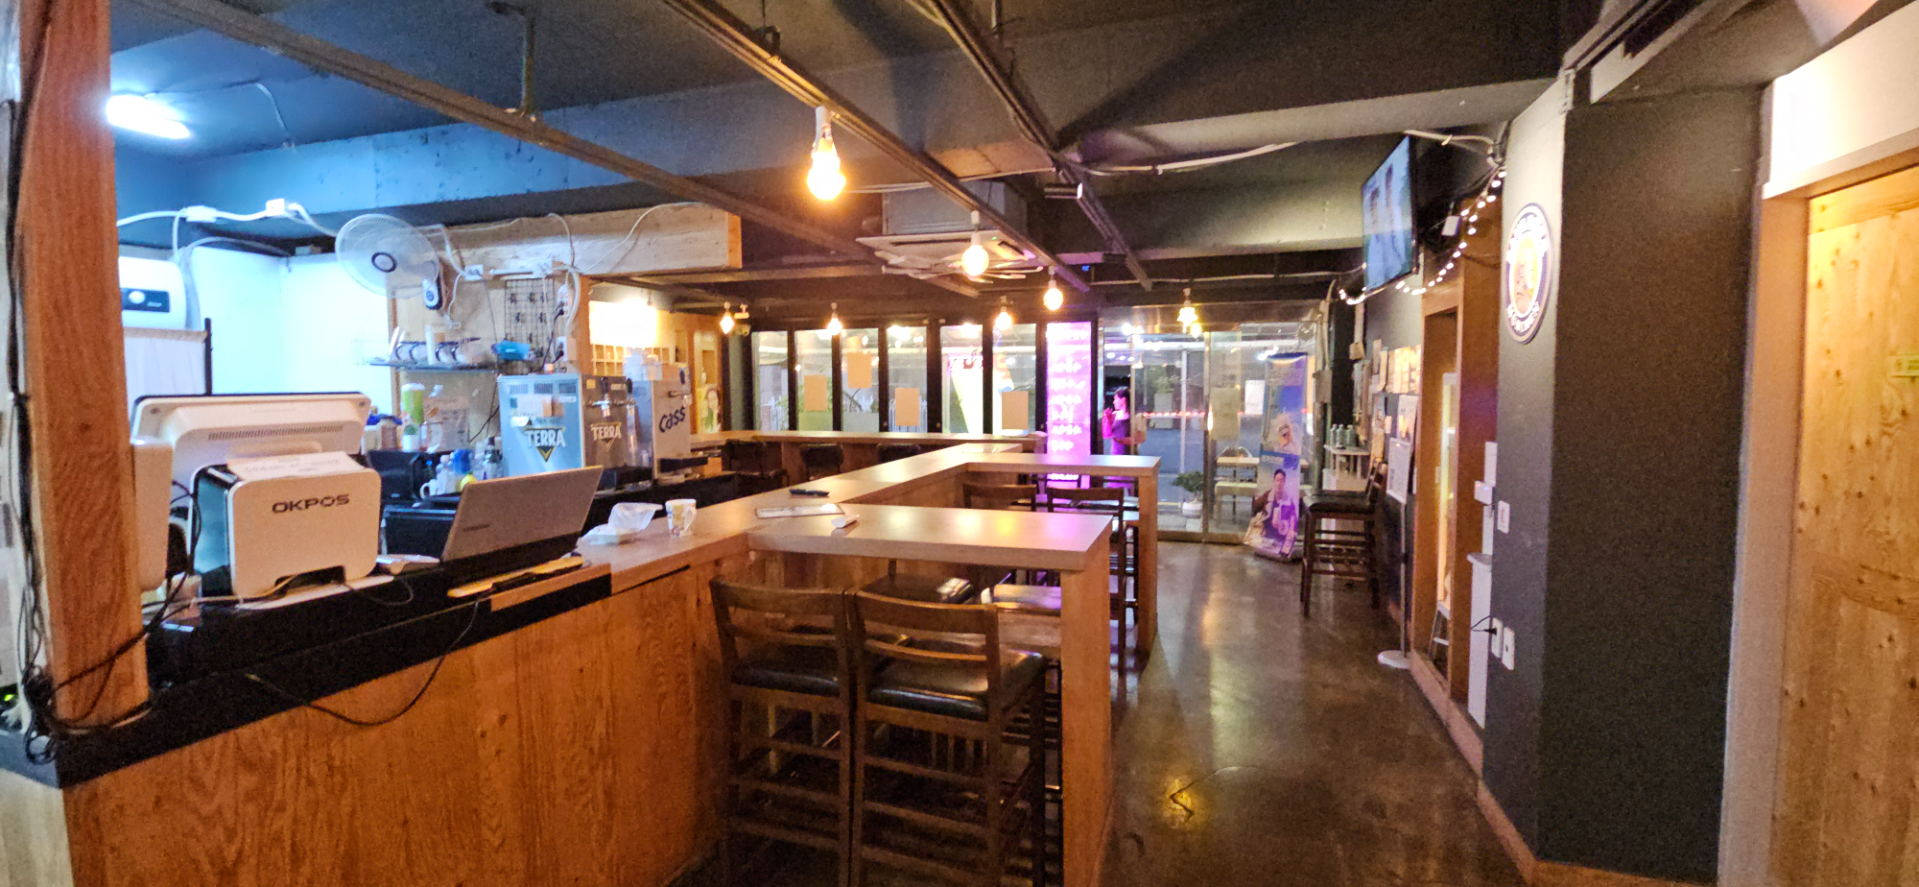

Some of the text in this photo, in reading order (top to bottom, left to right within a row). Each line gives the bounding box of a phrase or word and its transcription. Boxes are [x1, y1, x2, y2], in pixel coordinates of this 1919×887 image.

[525, 428, 567, 449] TERRA
[591, 424, 622, 441] TERRA
[271, 494, 351, 514] OKPOS
